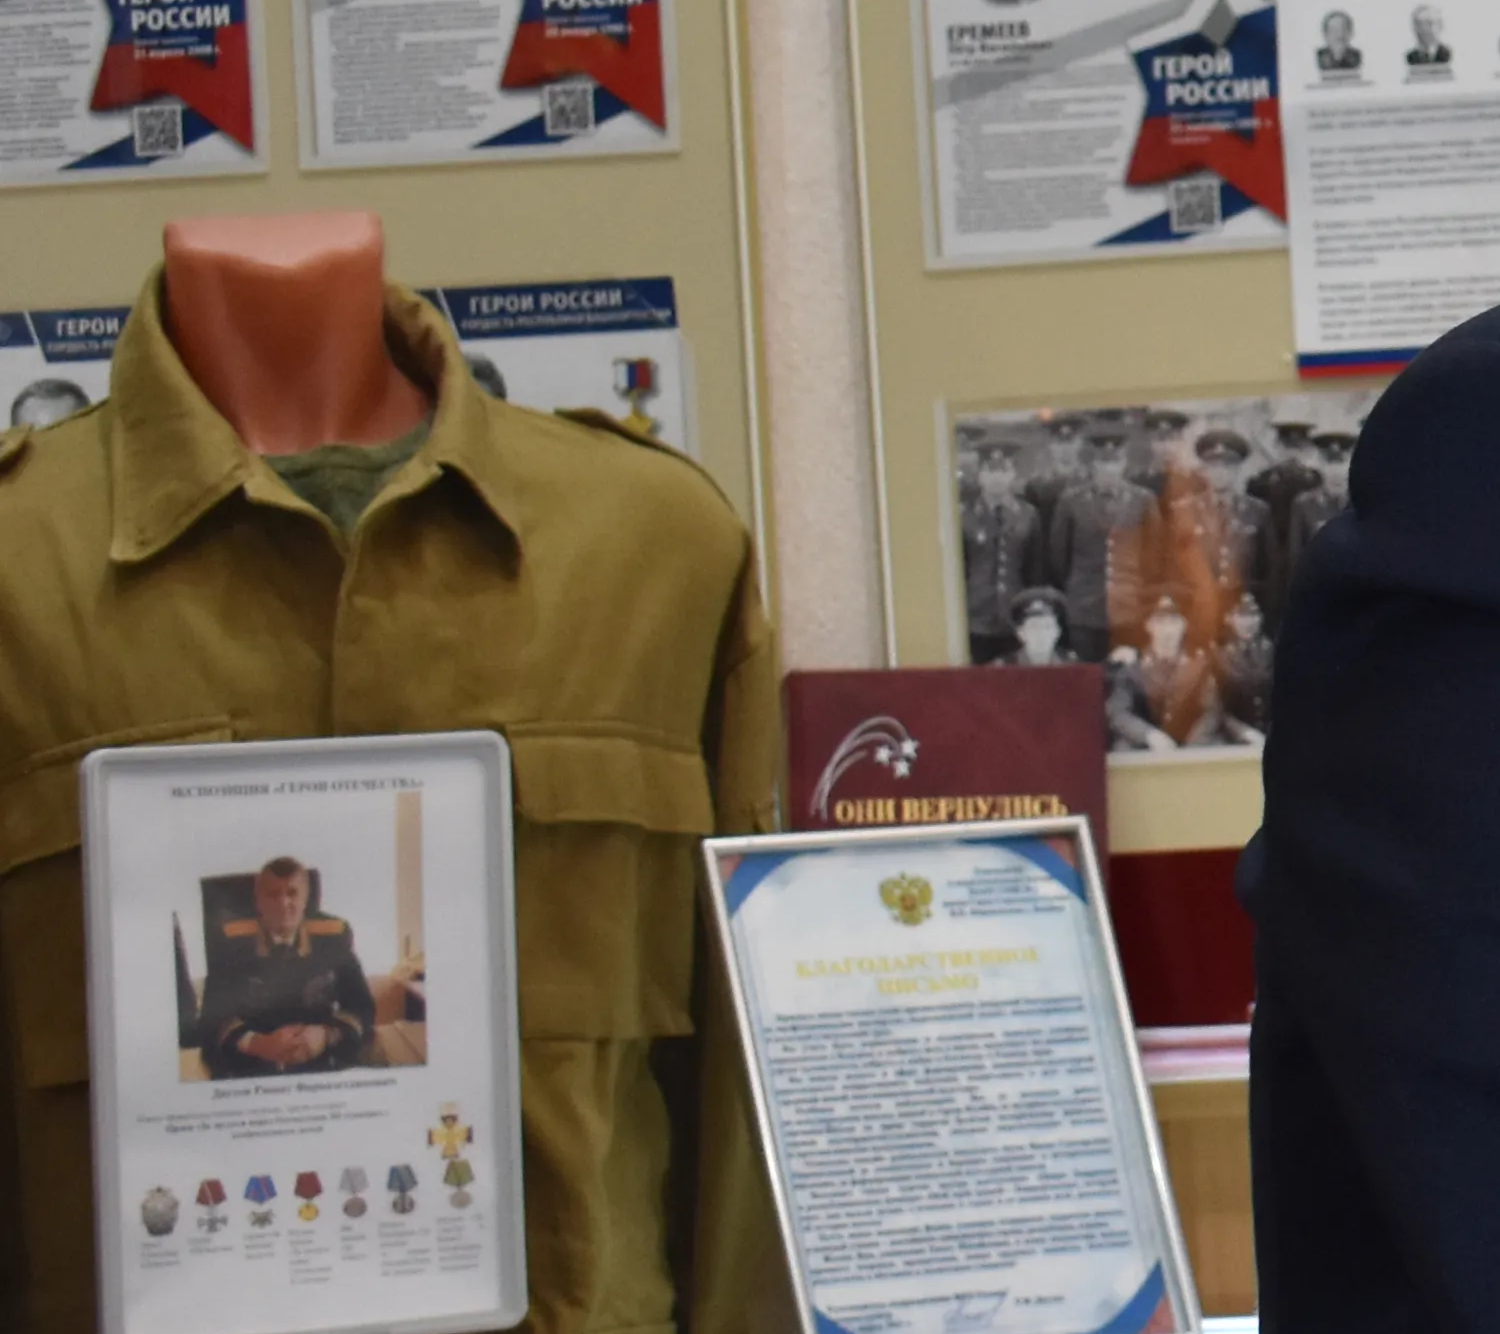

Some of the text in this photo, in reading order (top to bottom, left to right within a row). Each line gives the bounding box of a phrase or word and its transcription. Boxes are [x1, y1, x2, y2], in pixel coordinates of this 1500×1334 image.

[131, 4, 231, 32] РОССИИ
[1153, 49, 1233, 80] ГЕРОЙ
[1166, 77, 1270, 106] РОССИИ
[469, 287, 622, 316] ГЕРОИ РОССИИ
[57, 316, 119, 338] ГЕРОИ
[834, 793, 1068, 824] ОНИ ВЕРНУЛИСЬ
